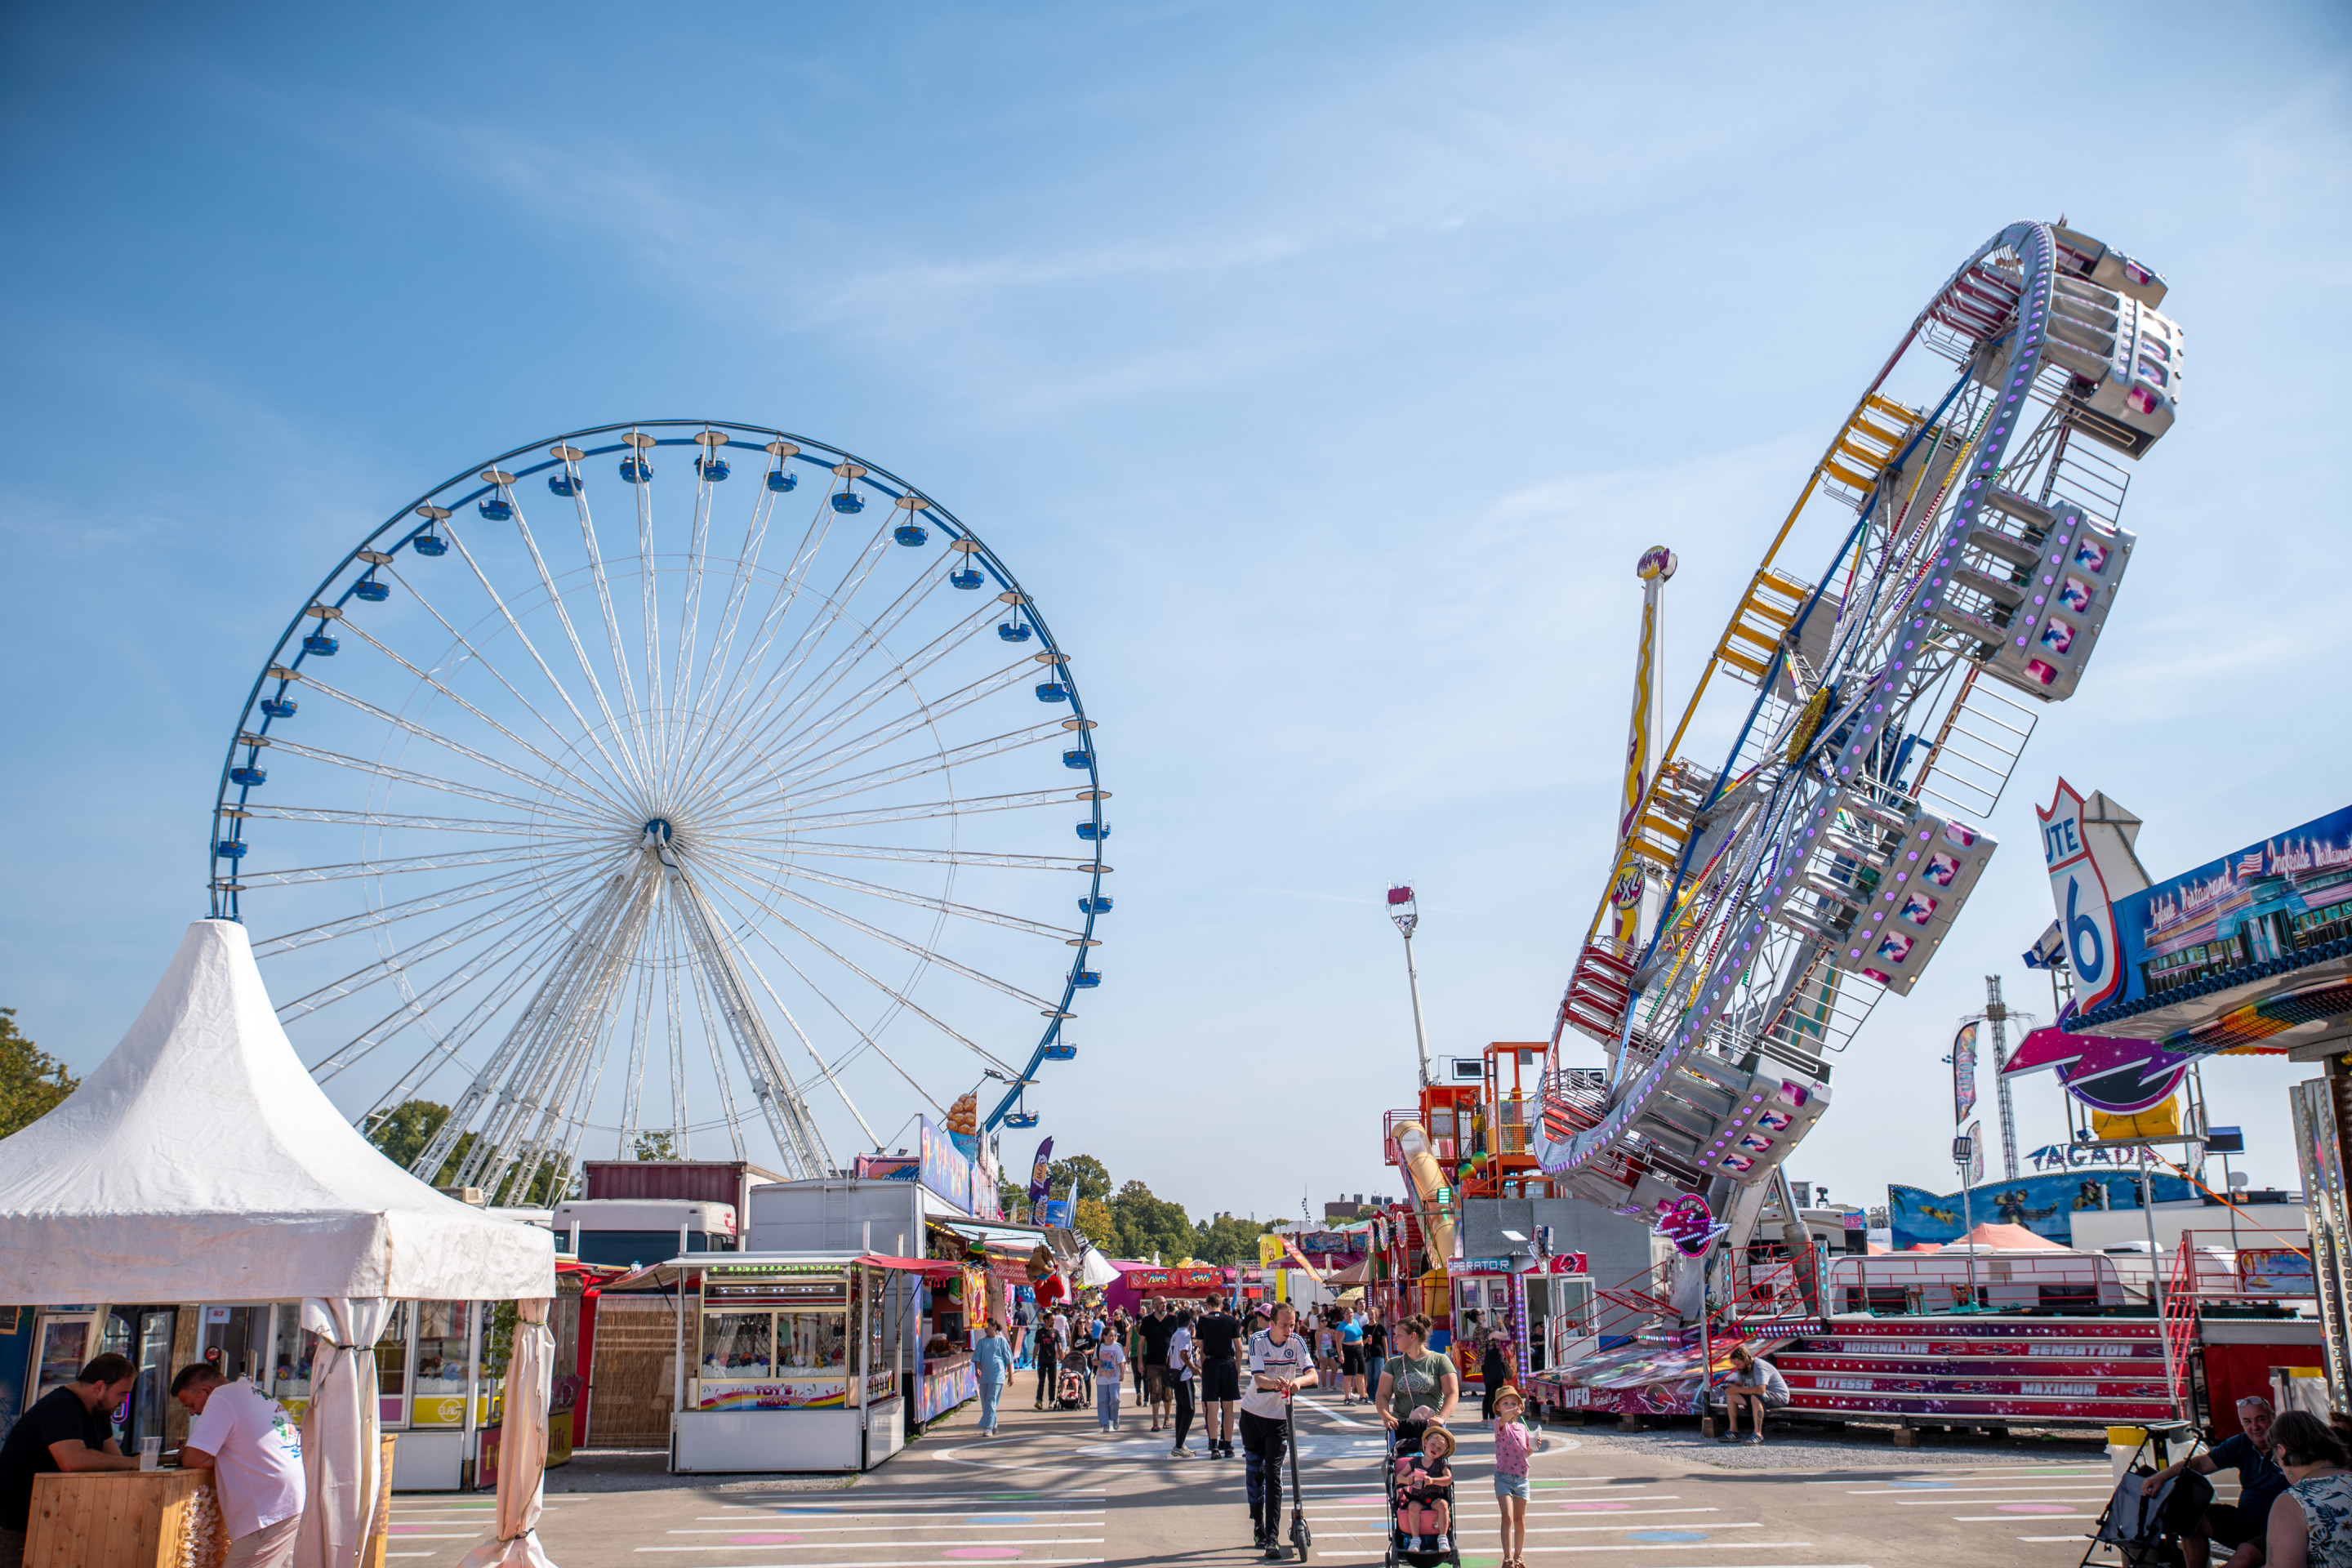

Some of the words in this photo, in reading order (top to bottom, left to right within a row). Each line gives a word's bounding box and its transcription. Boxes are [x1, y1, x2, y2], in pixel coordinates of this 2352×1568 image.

[1613, 871, 1639, 901] XXL
[2180, 860, 2232, 911] Restaurant
[2066, 875, 2104, 983] 6
[1959, 1062, 1973, 1092] UFO
[2023, 1143, 2159, 1172] TAGADA
[1681, 1200, 1704, 1213] UFO
[1449, 1260, 1509, 1271] OPERATOR
[1842, 1342, 1930, 1354] ADRENALINE
[2029, 1343, 2133, 1357] SENSATION
[755, 1383, 793, 1396] TOY'S
[1815, 1377, 1873, 1390] VITESSE
[2020, 1383, 2098, 1396] MAXIMUM
[756, 1398, 790, 1407] JEUX
[1565, 1388, 1589, 1409] UFO
